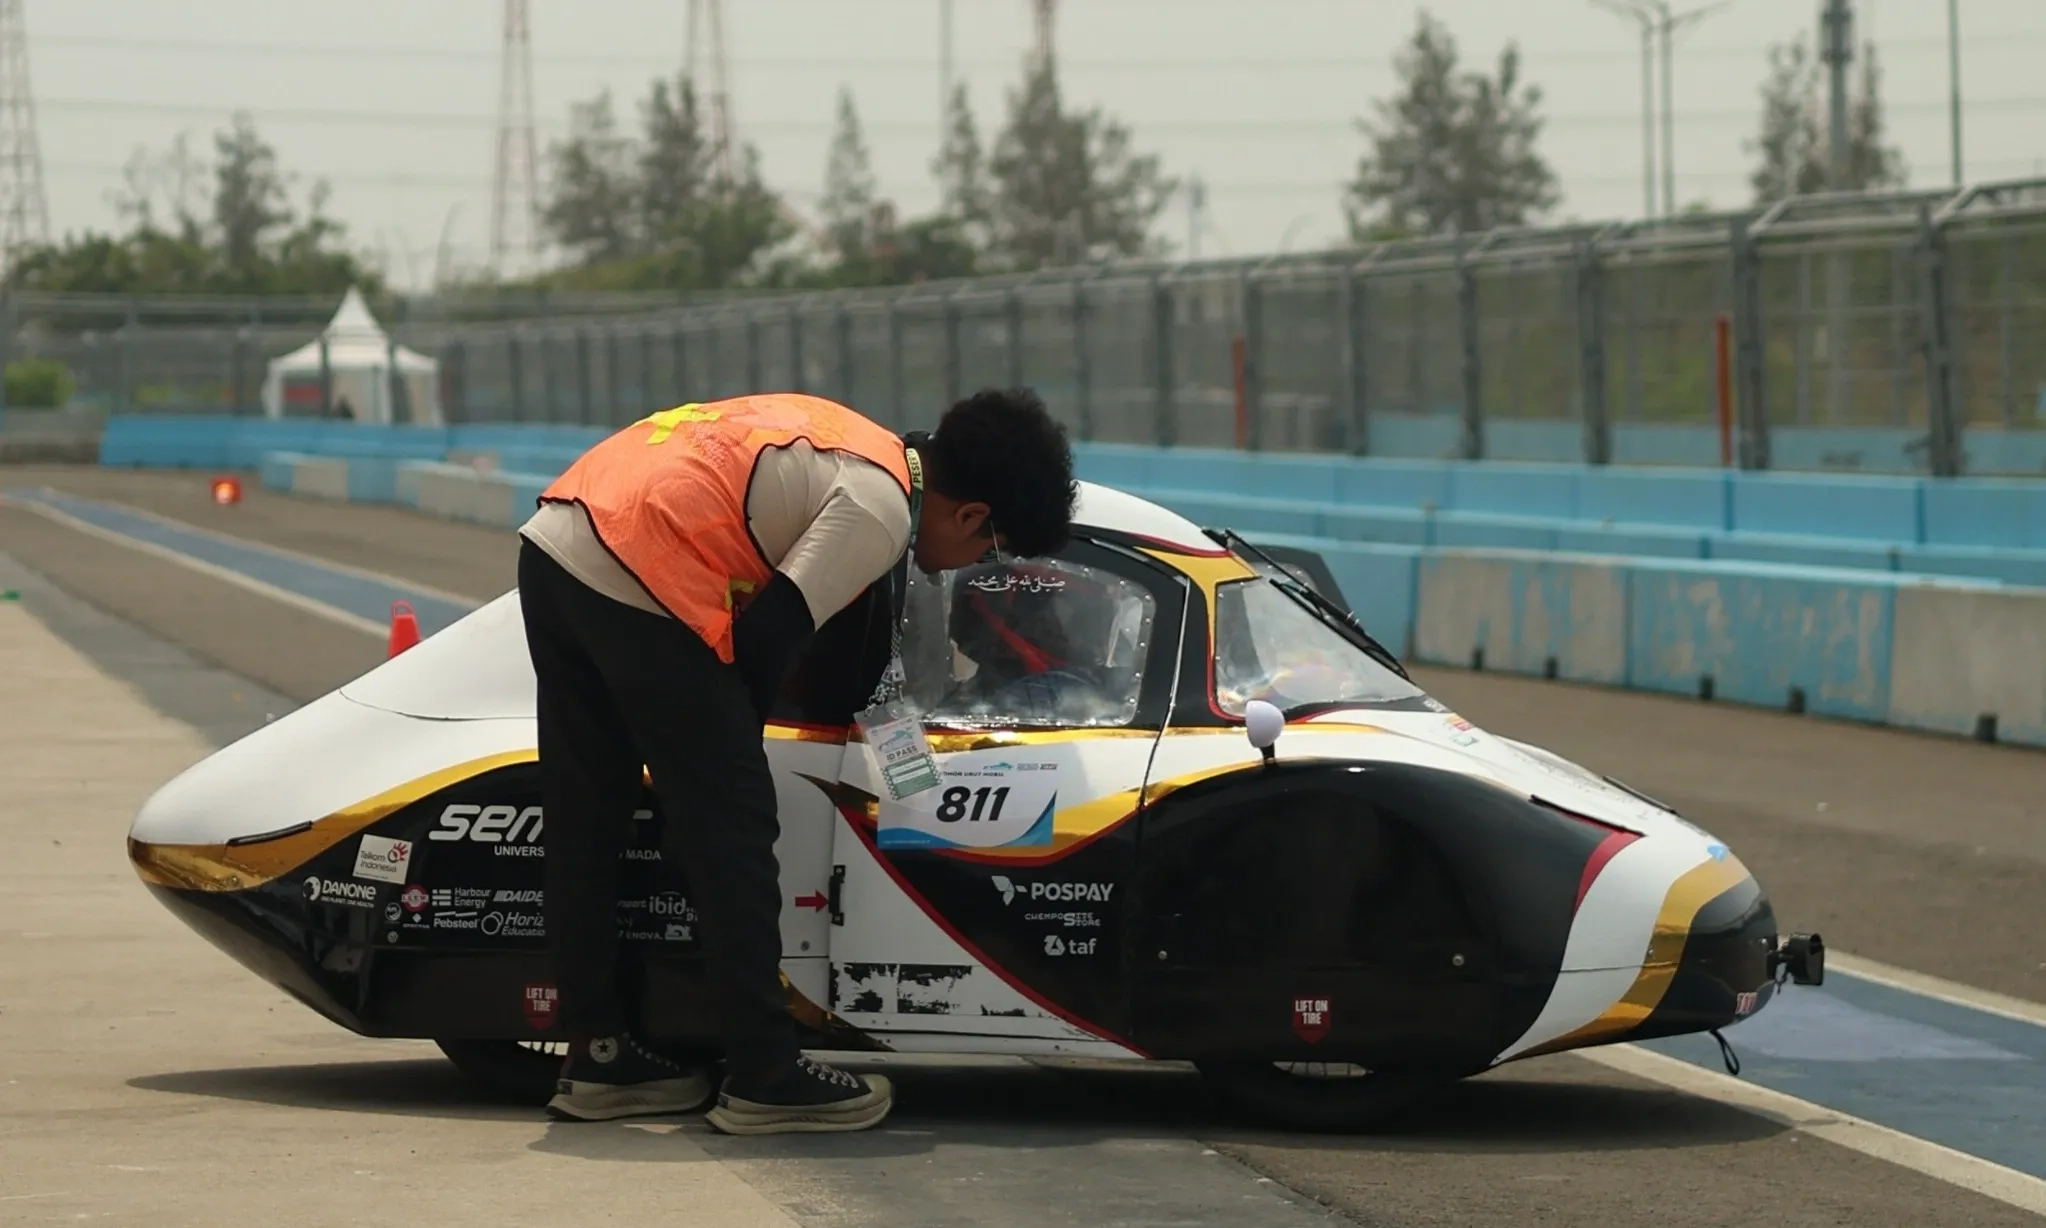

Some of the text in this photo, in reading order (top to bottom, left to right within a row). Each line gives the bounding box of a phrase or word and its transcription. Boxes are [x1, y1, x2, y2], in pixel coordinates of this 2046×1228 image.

[887, 745, 917, 762] ID PASS
[936, 786, 1011, 822] 811
[360, 850, 386, 862] Telkom
[625, 849, 662, 860] MADA
[454, 887, 492, 897] Harbour
[1031, 882, 1114, 901] POSPAY
[454, 898, 486, 909] Energy
[649, 896, 687, 915] ibid
[433, 917, 478, 929] Pebsteel
[1068, 937, 1098, 955] taf
[526, 987, 543, 999] LIFT
[533, 999, 551, 1012] TIRE
[1295, 999, 1328, 1012] LIFT ON
[1302, 1012, 1322, 1025] TIRE
